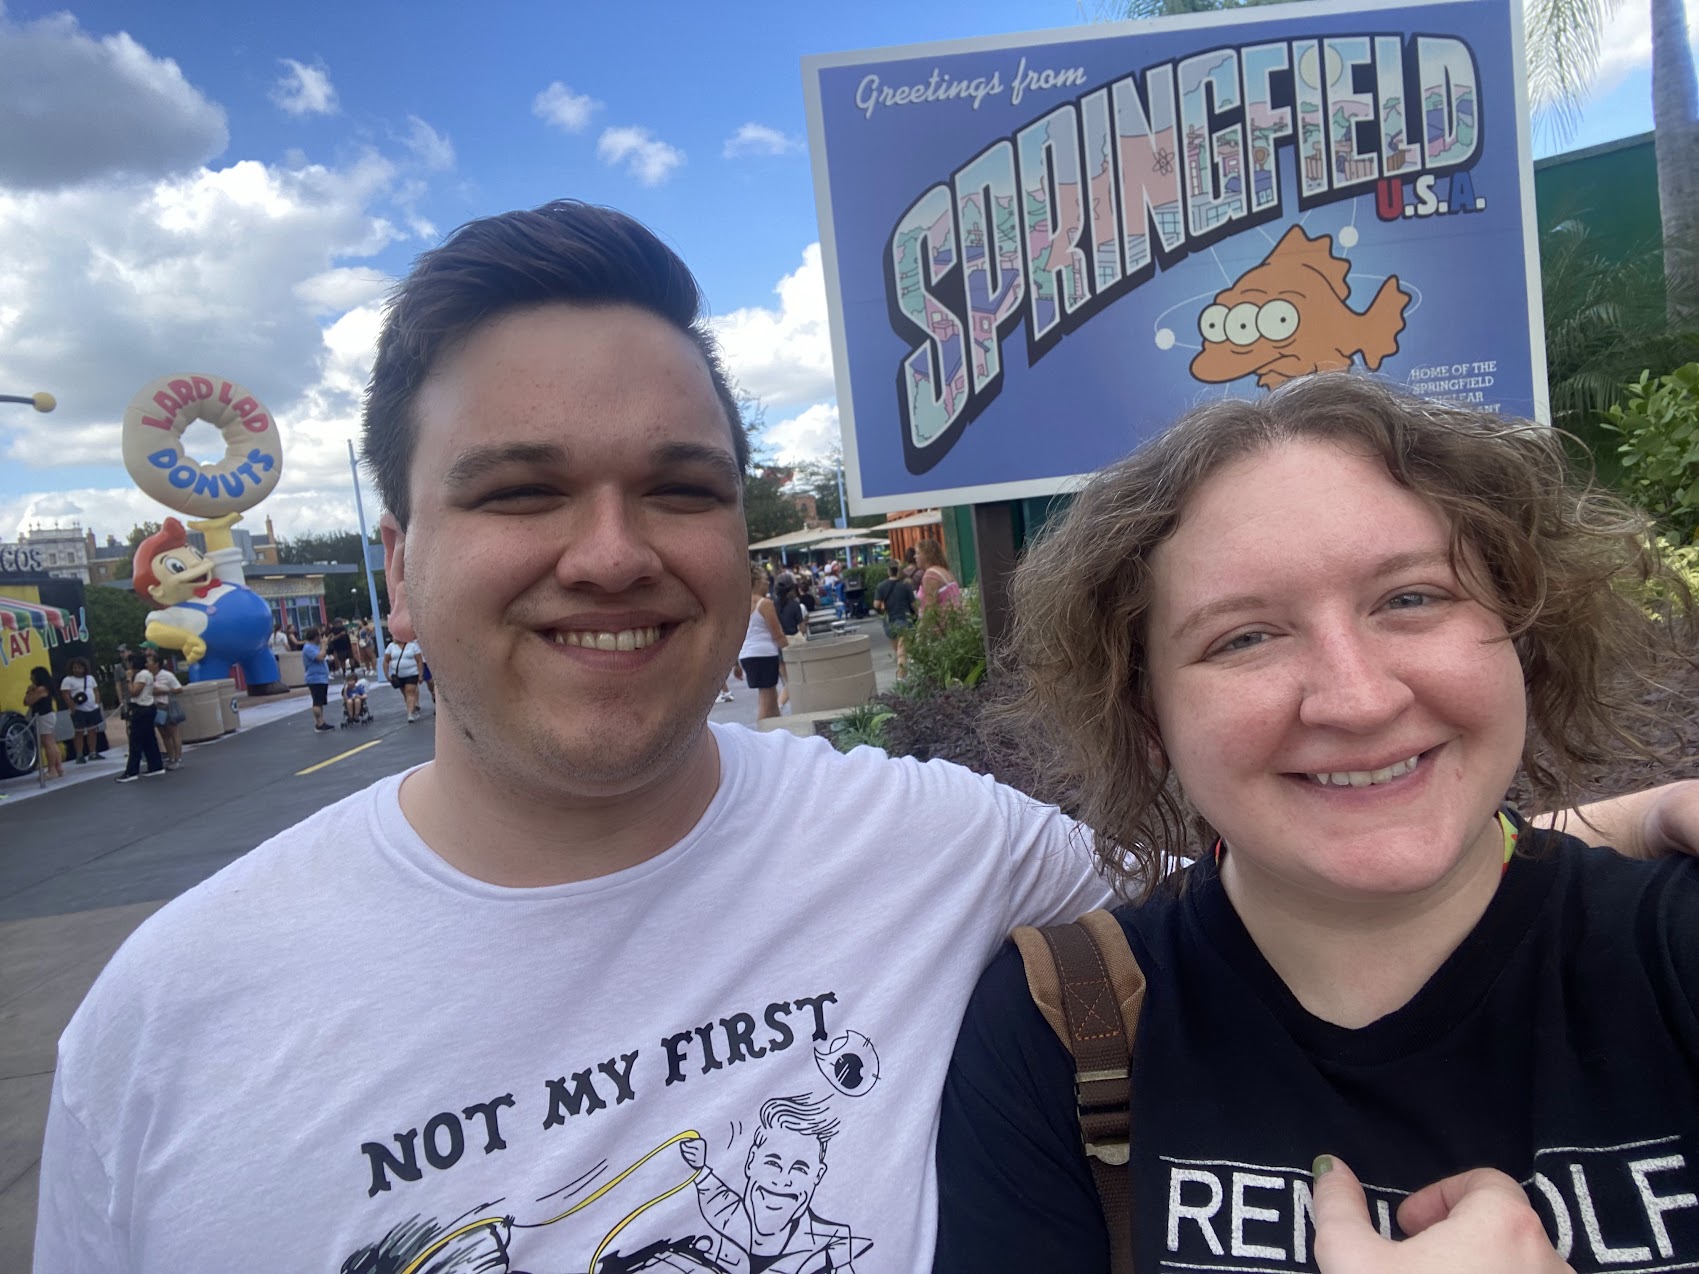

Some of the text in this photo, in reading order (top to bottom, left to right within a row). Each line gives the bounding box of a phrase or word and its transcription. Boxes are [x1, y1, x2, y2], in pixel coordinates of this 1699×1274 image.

[855, 56, 1087, 120] Greetings from
[1376, 170, 1486, 221] U.S.A.
[888, 33, 1481, 462] SPRINGFIELD
[1411, 361, 1497, 380] HOME OF THE
[1412, 376, 1494, 394] SPRINGFIELD
[141, 376, 269, 433] LARD LAD
[147, 448, 275, 498] DONUTS
[0, 547, 43, 572] COS
[361, 991, 838, 1198] NOT MY FIRST
